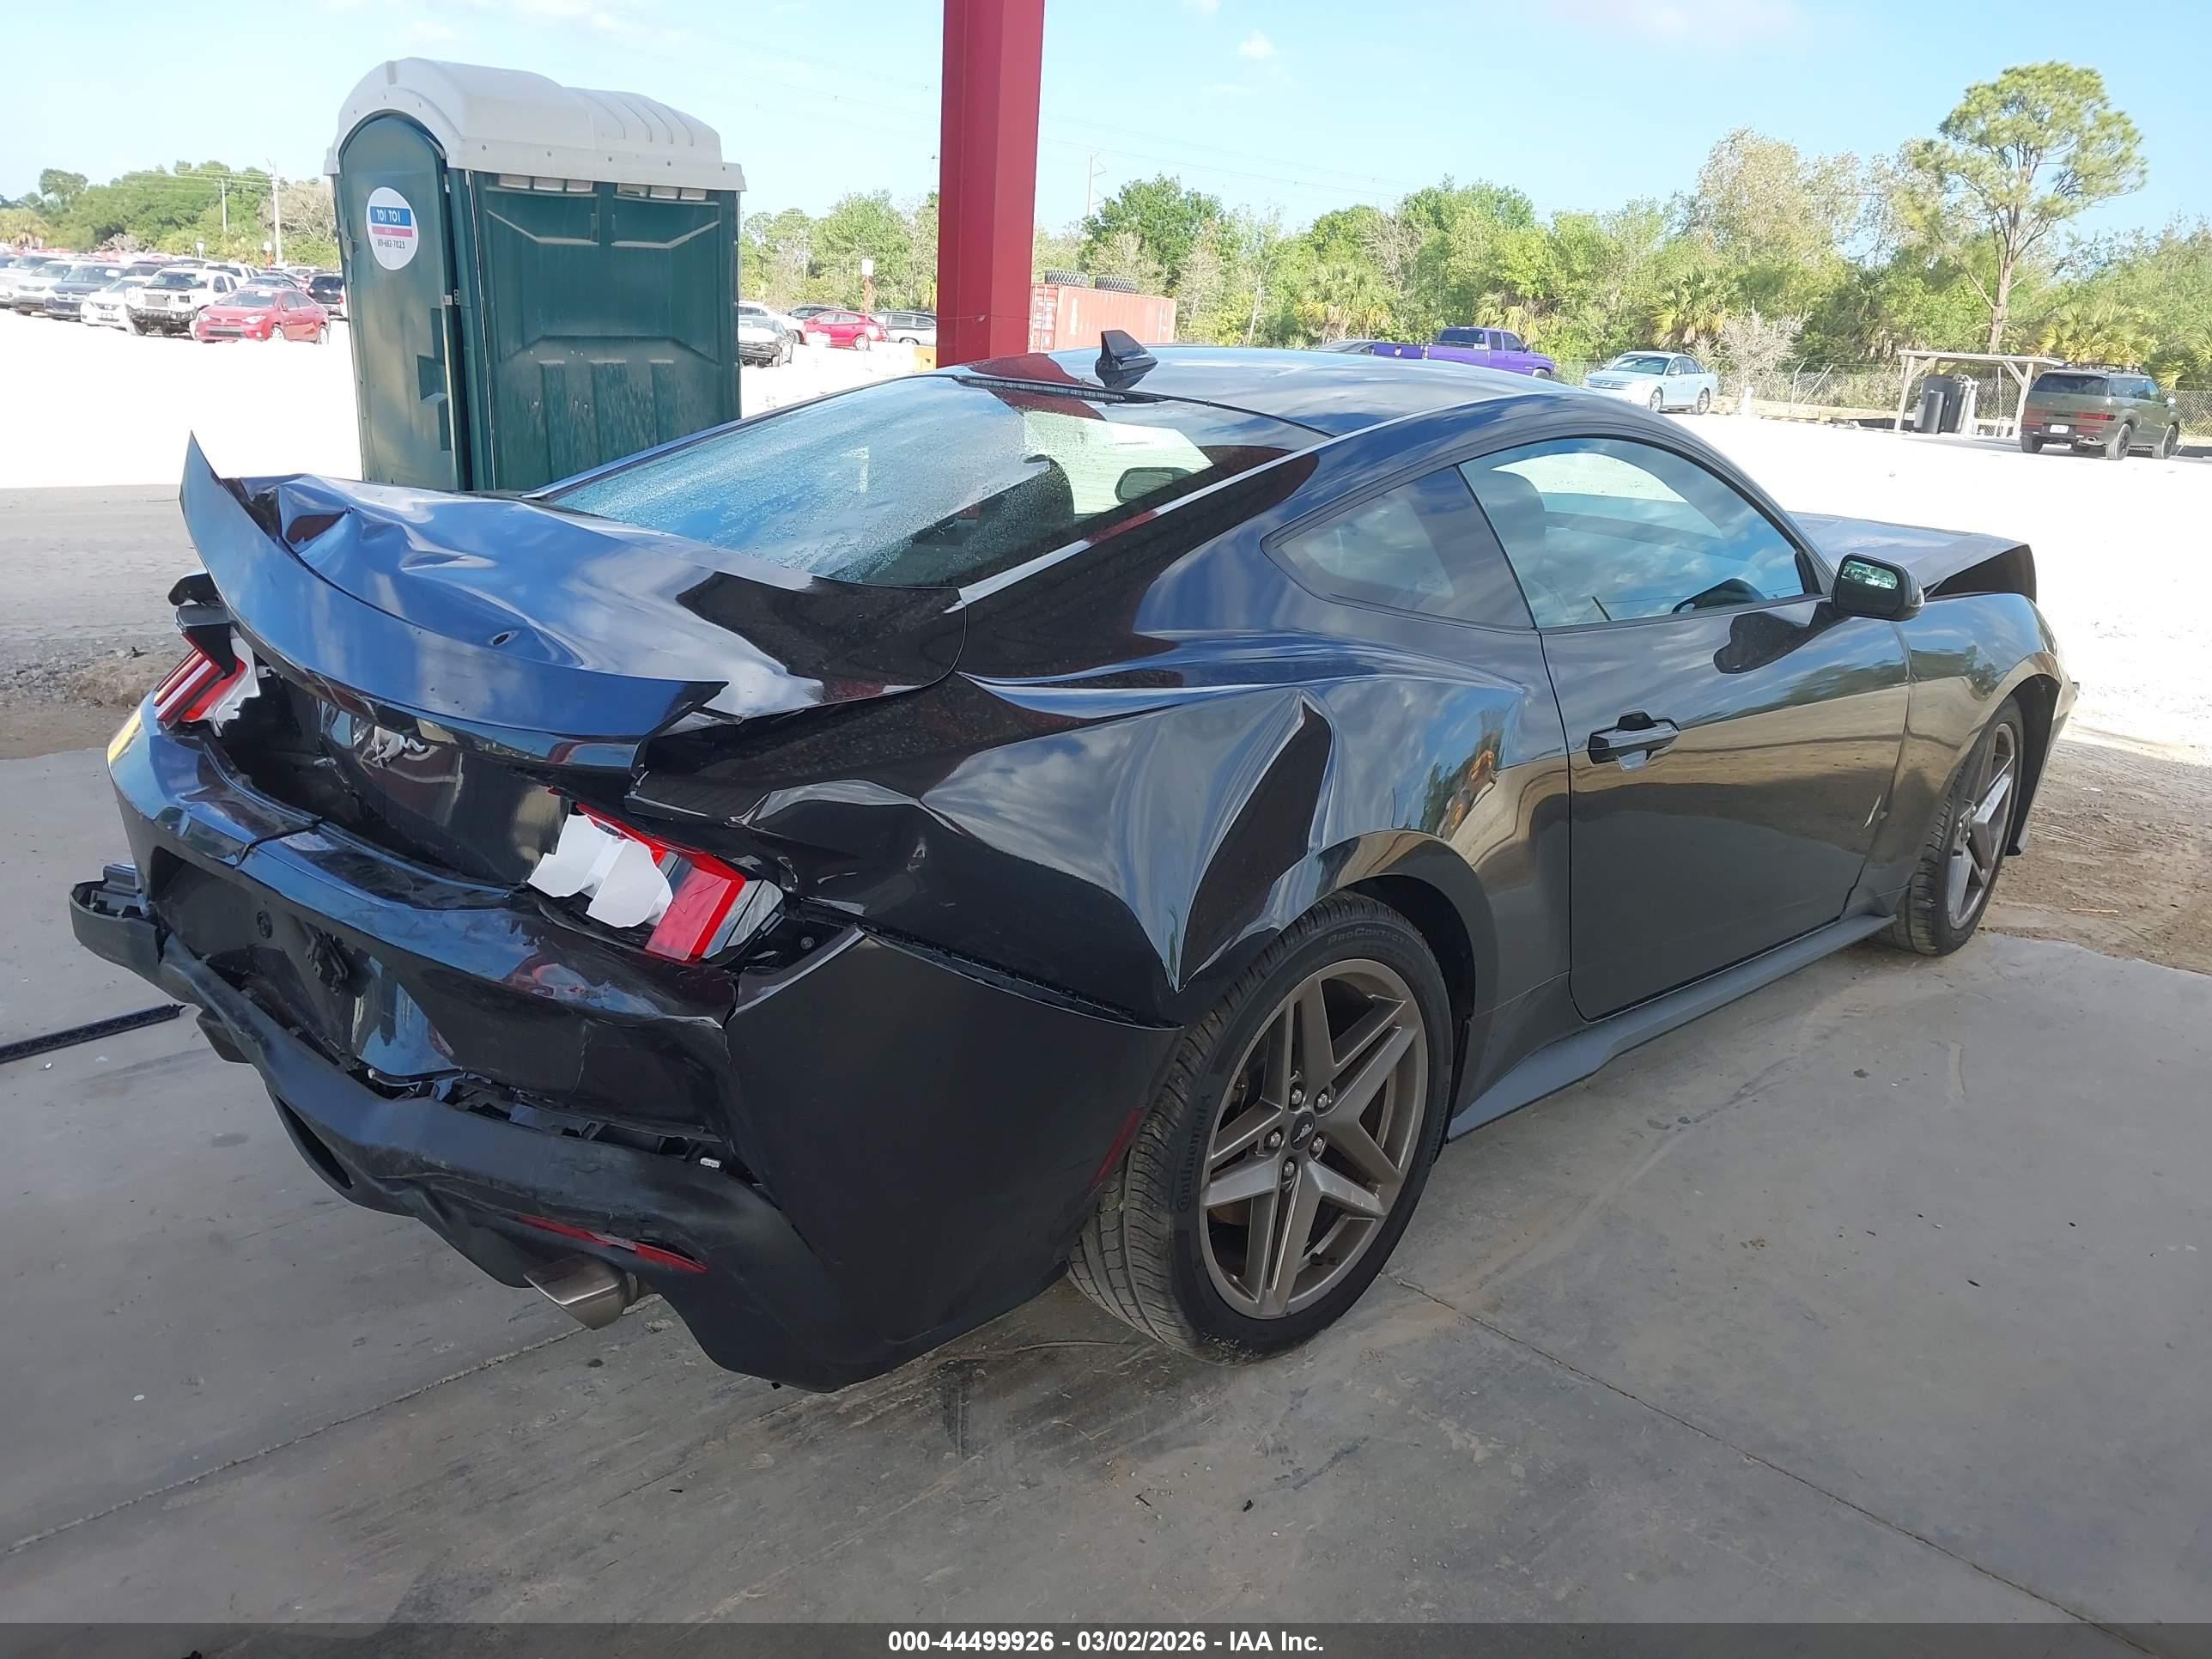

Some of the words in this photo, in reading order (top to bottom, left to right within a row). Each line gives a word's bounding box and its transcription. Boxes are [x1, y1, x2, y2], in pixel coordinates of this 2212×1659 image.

[377, 210, 386, 222] TOI
[388, 210, 401, 222] TOI
[377, 239, 405, 249] -682-7023
